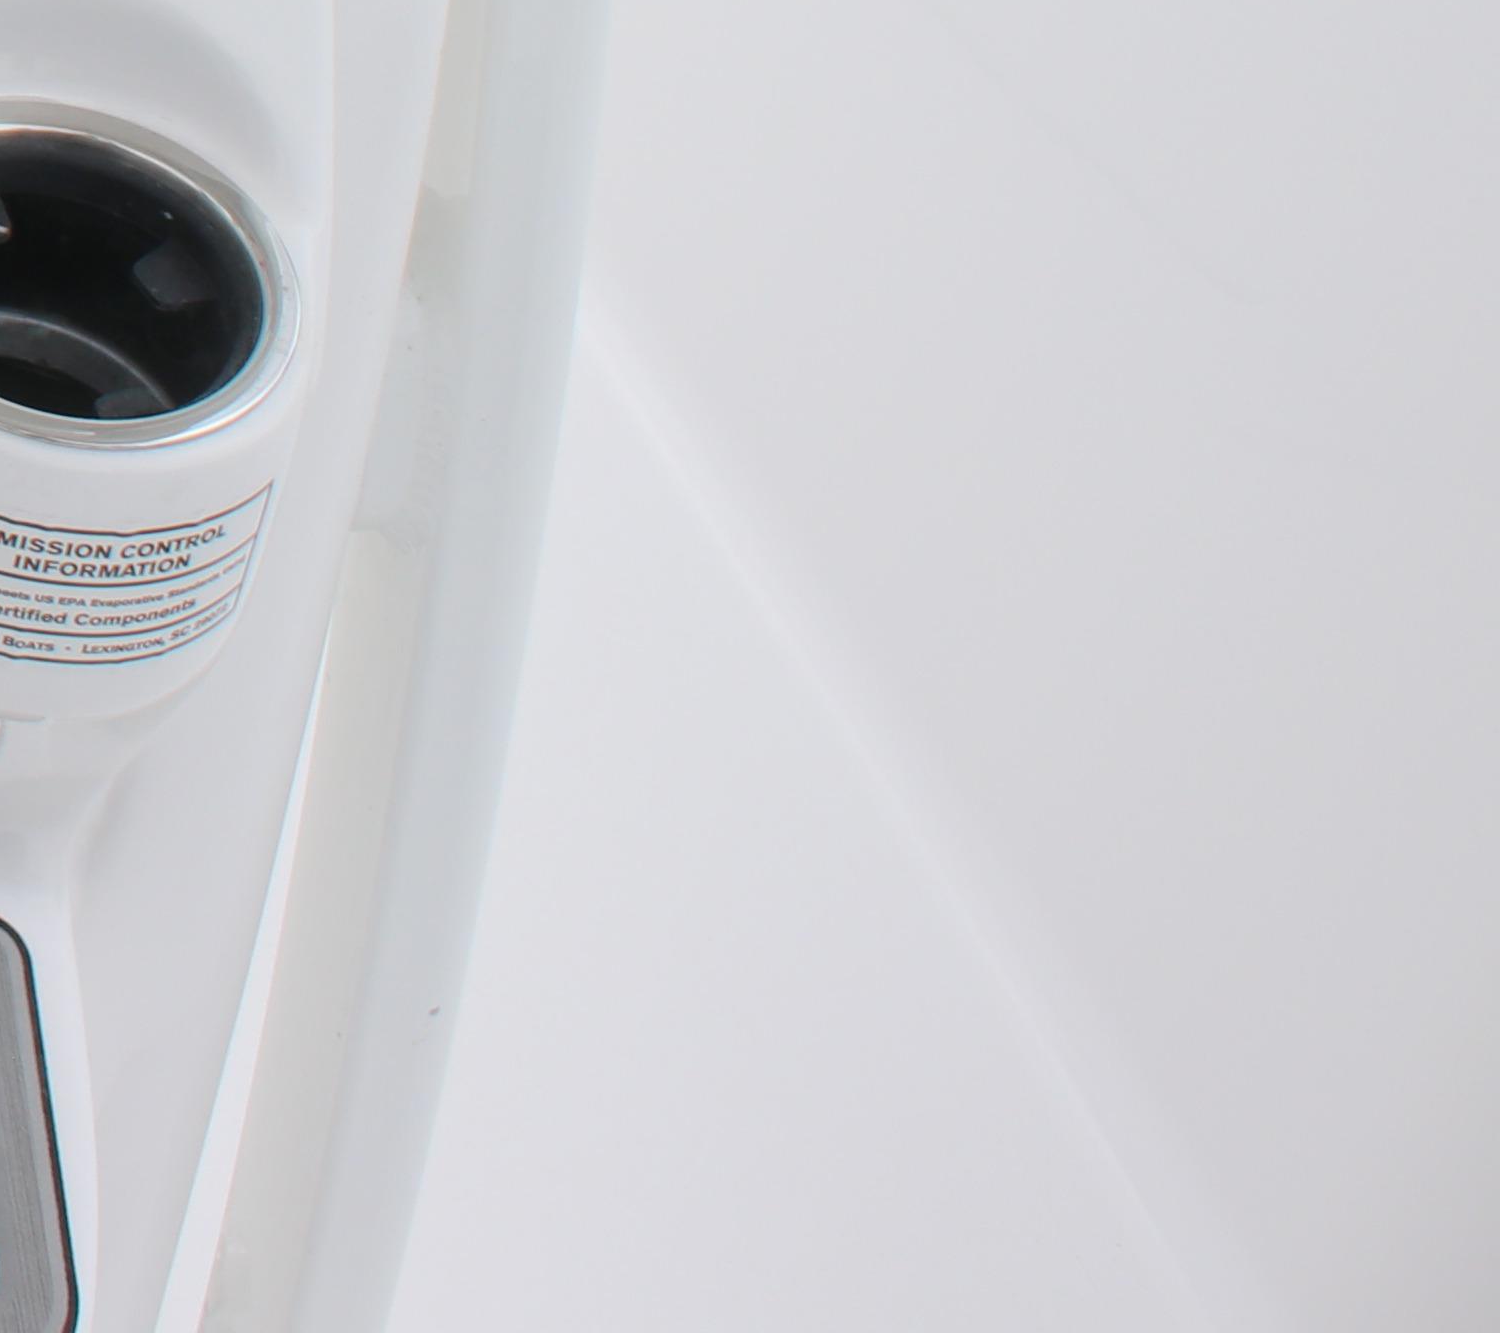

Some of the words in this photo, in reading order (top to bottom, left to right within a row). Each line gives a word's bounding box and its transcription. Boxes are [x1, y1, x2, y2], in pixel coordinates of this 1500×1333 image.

[120, 524, 226, 559] CONTROL
[13, 554, 192, 579] INFORMATION
[34, 594, 55, 605] US
[58, 597, 87, 608] EPA
[90, 593, 164, 608] Evaporative
[73, 598, 197, 627] Components
